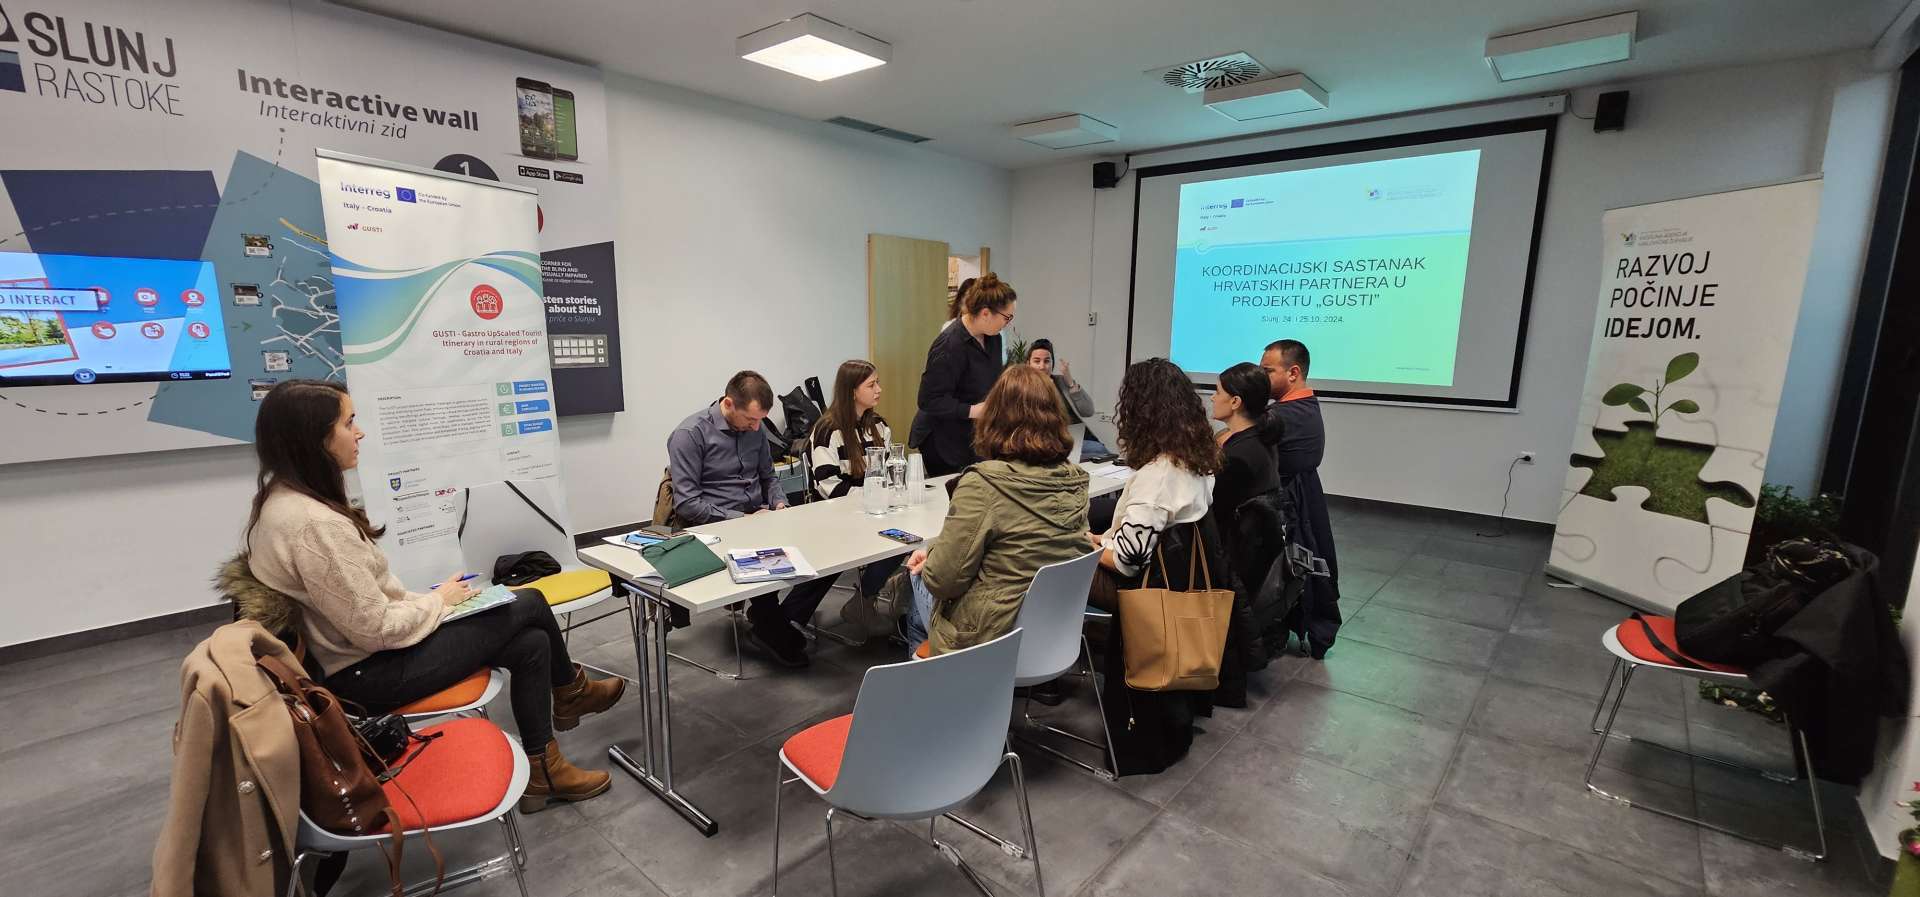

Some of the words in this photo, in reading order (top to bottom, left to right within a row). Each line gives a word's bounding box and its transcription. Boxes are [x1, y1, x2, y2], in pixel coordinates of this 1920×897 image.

[24, 12, 177, 78] SLUNJ
[34, 63, 184, 117] RASTOKE
[237, 68, 418, 122] Interactive
[422, 106, 480, 131] wall
[260, 100, 376, 135] Interaktivni
[381, 124, 408, 140] zid
[343, 202, 360, 212] Italy
[367, 205, 393, 214] Croatia
[362, 225, 384, 233] GUSTI
[1202, 261, 1328, 277] KOORDINACIJSKI
[1332, 256, 1426, 273] SASTANAK
[1616, 250, 1711, 279] RAZVOJ
[1213, 279, 1295, 292] HRVATSKIH
[1299, 275, 1389, 290] PARTNERA
[1394, 275, 1407, 288] U
[10, 294, 76, 306] INTERACT
[565, 295, 598, 305] stories
[1610, 280, 1719, 309] POČINJE
[1231, 295, 1312, 307] PROJEKTU
[548, 304, 577, 313] about
[578, 304, 601, 316] Slunj
[1323, 315, 1345, 323] 2024.
[432, 330, 456, 338] GUSTI
[487, 329, 520, 339] UpScaled
[1604, 317, 1702, 340] IDEJOM.
[443, 340, 475, 348] Itinerary
[505, 338, 530, 347] regions
[463, 348, 490, 356] Croatia
[492, 347, 505, 355] and
[507, 347, 523, 356] Italy
